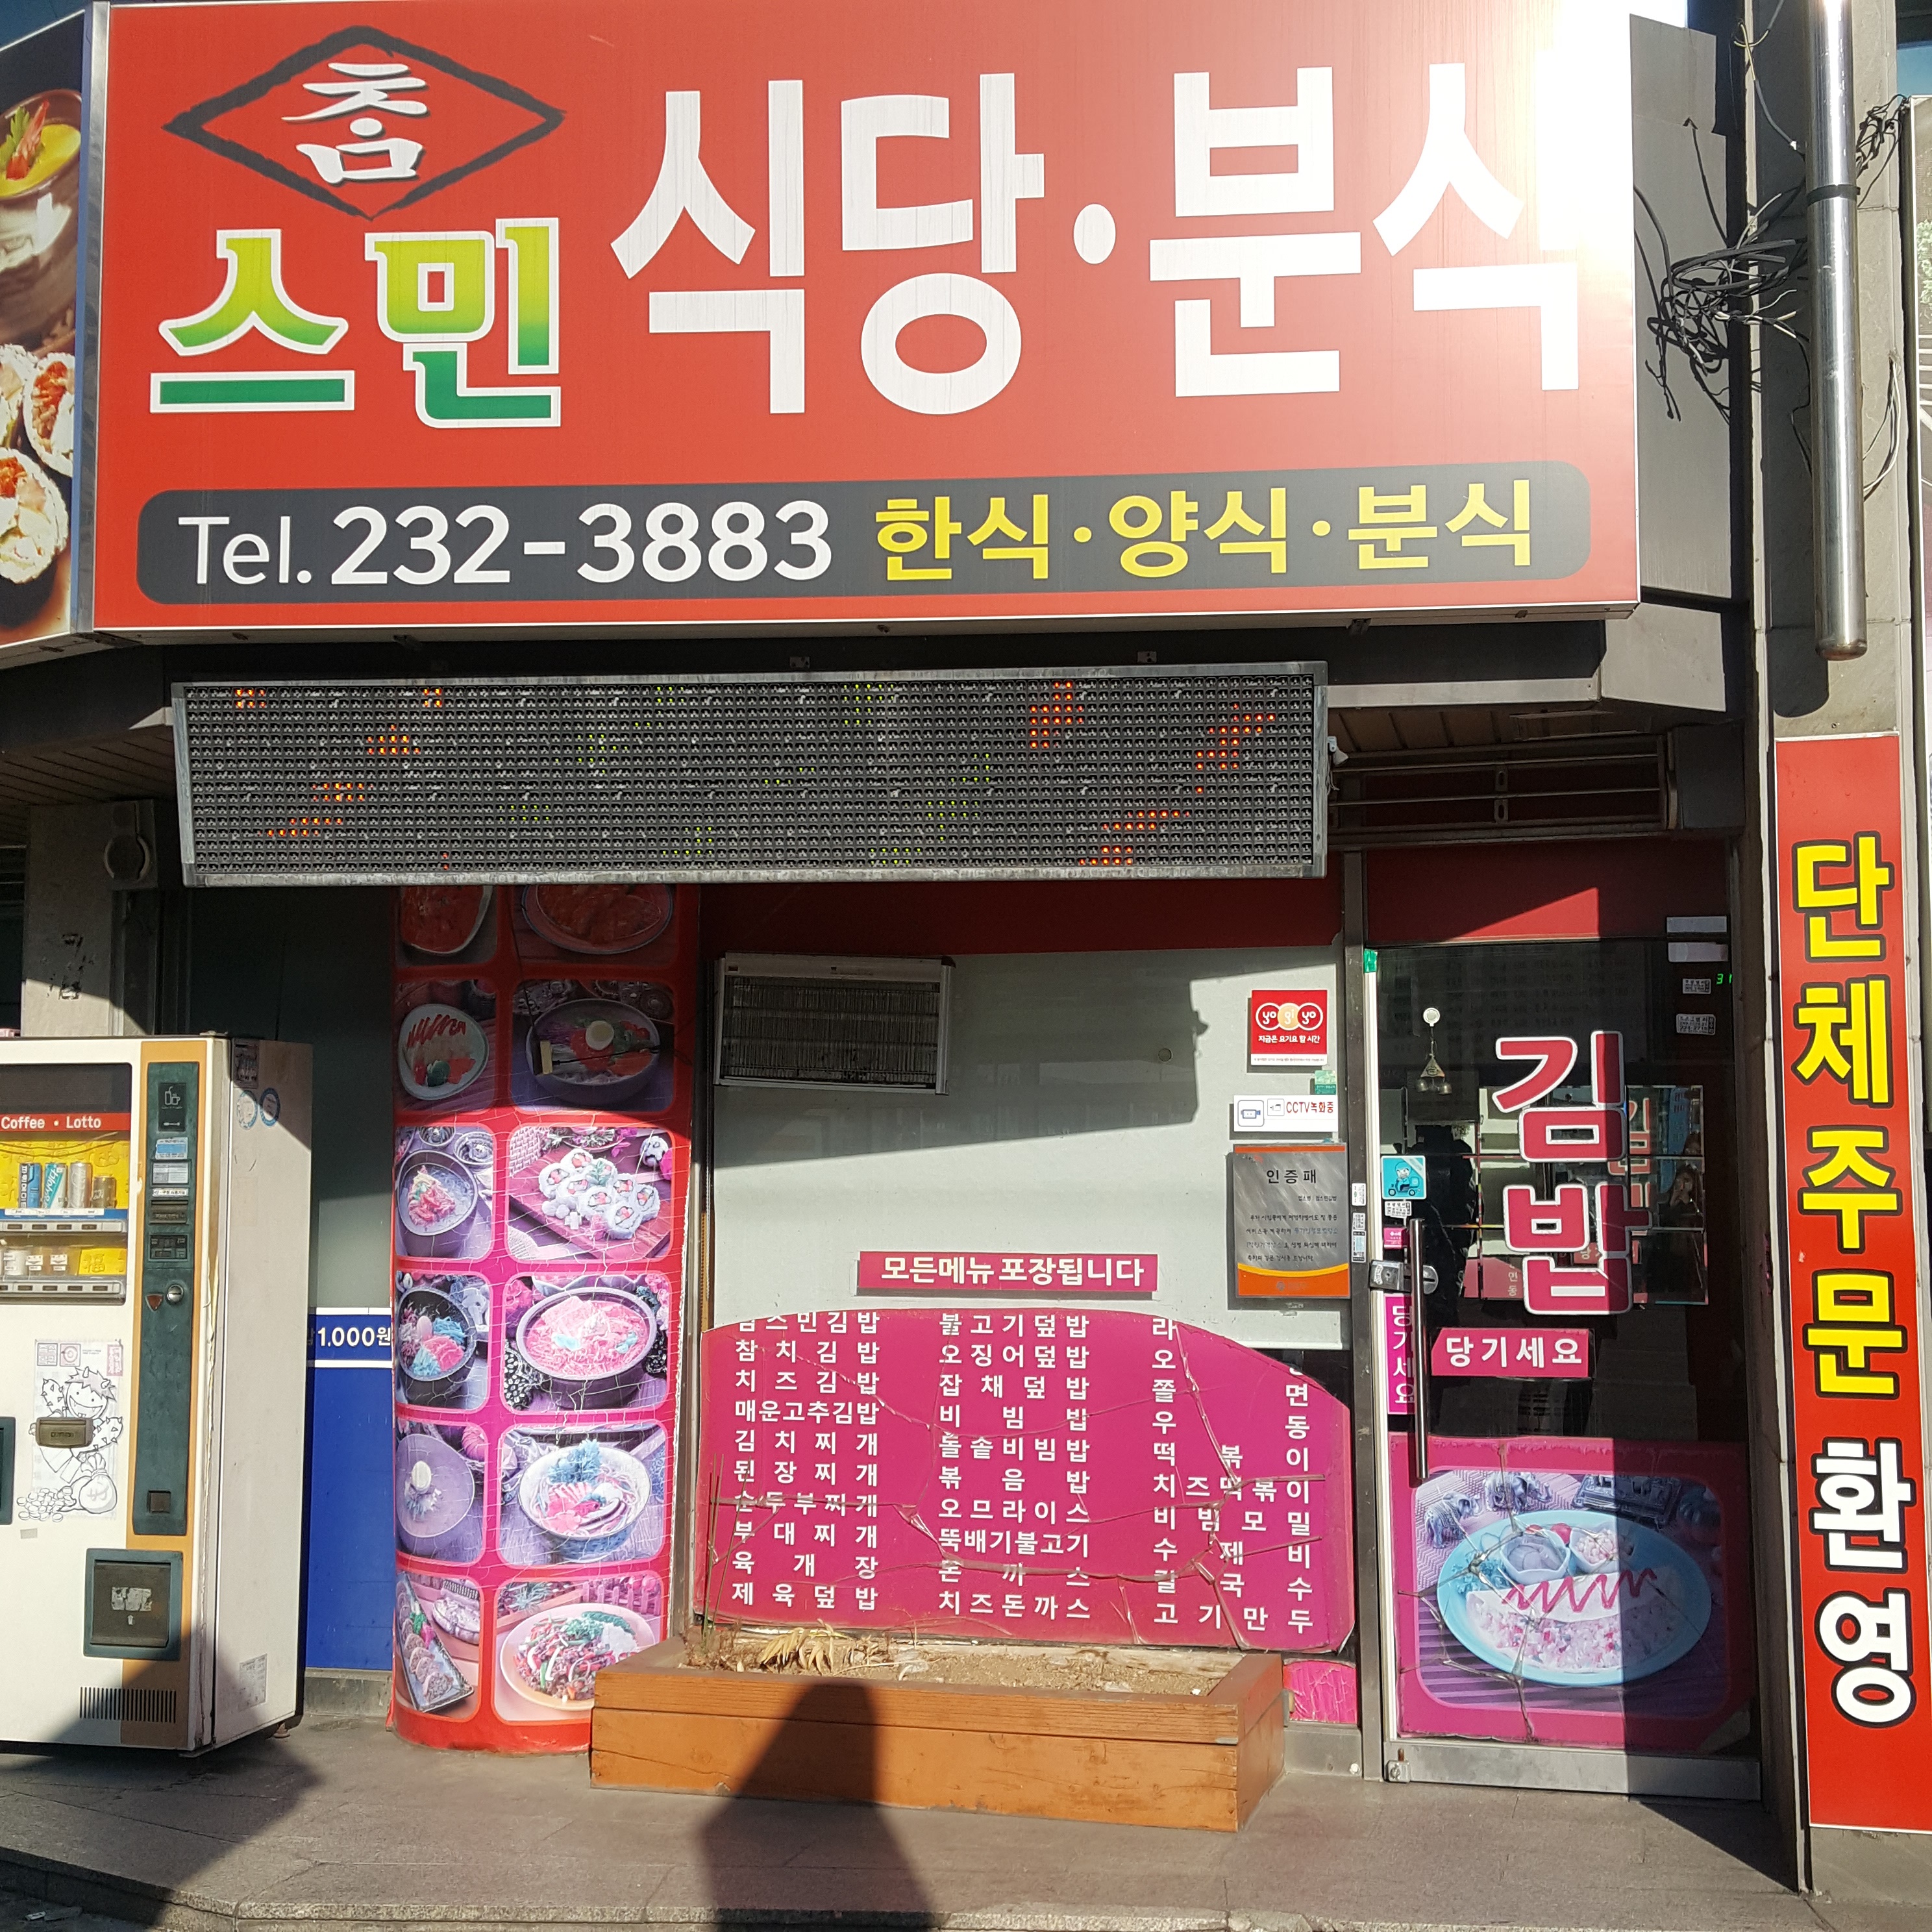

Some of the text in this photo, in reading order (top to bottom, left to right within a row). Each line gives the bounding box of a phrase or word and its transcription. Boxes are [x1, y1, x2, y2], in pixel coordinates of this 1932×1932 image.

[149, 216, 562, 429] 스민
[177, 515, 312, 585] Tel.
[330, 501, 833, 586] 232-3883
[1, 1115, 101, 1130] Coffee Lotto
[1266, 1169, 1317, 1184] 인증패
[880, 1256, 1145, 1287] 모든메뉴 포장됩니다
[1445, 1337, 1583, 1369] 당기세요
[734, 1400, 880, 1425] 매운고추김밥
[938, 1528, 1089, 1558] 뚝배기불고기
[1812, 1440, 1913, 1725] 환영
